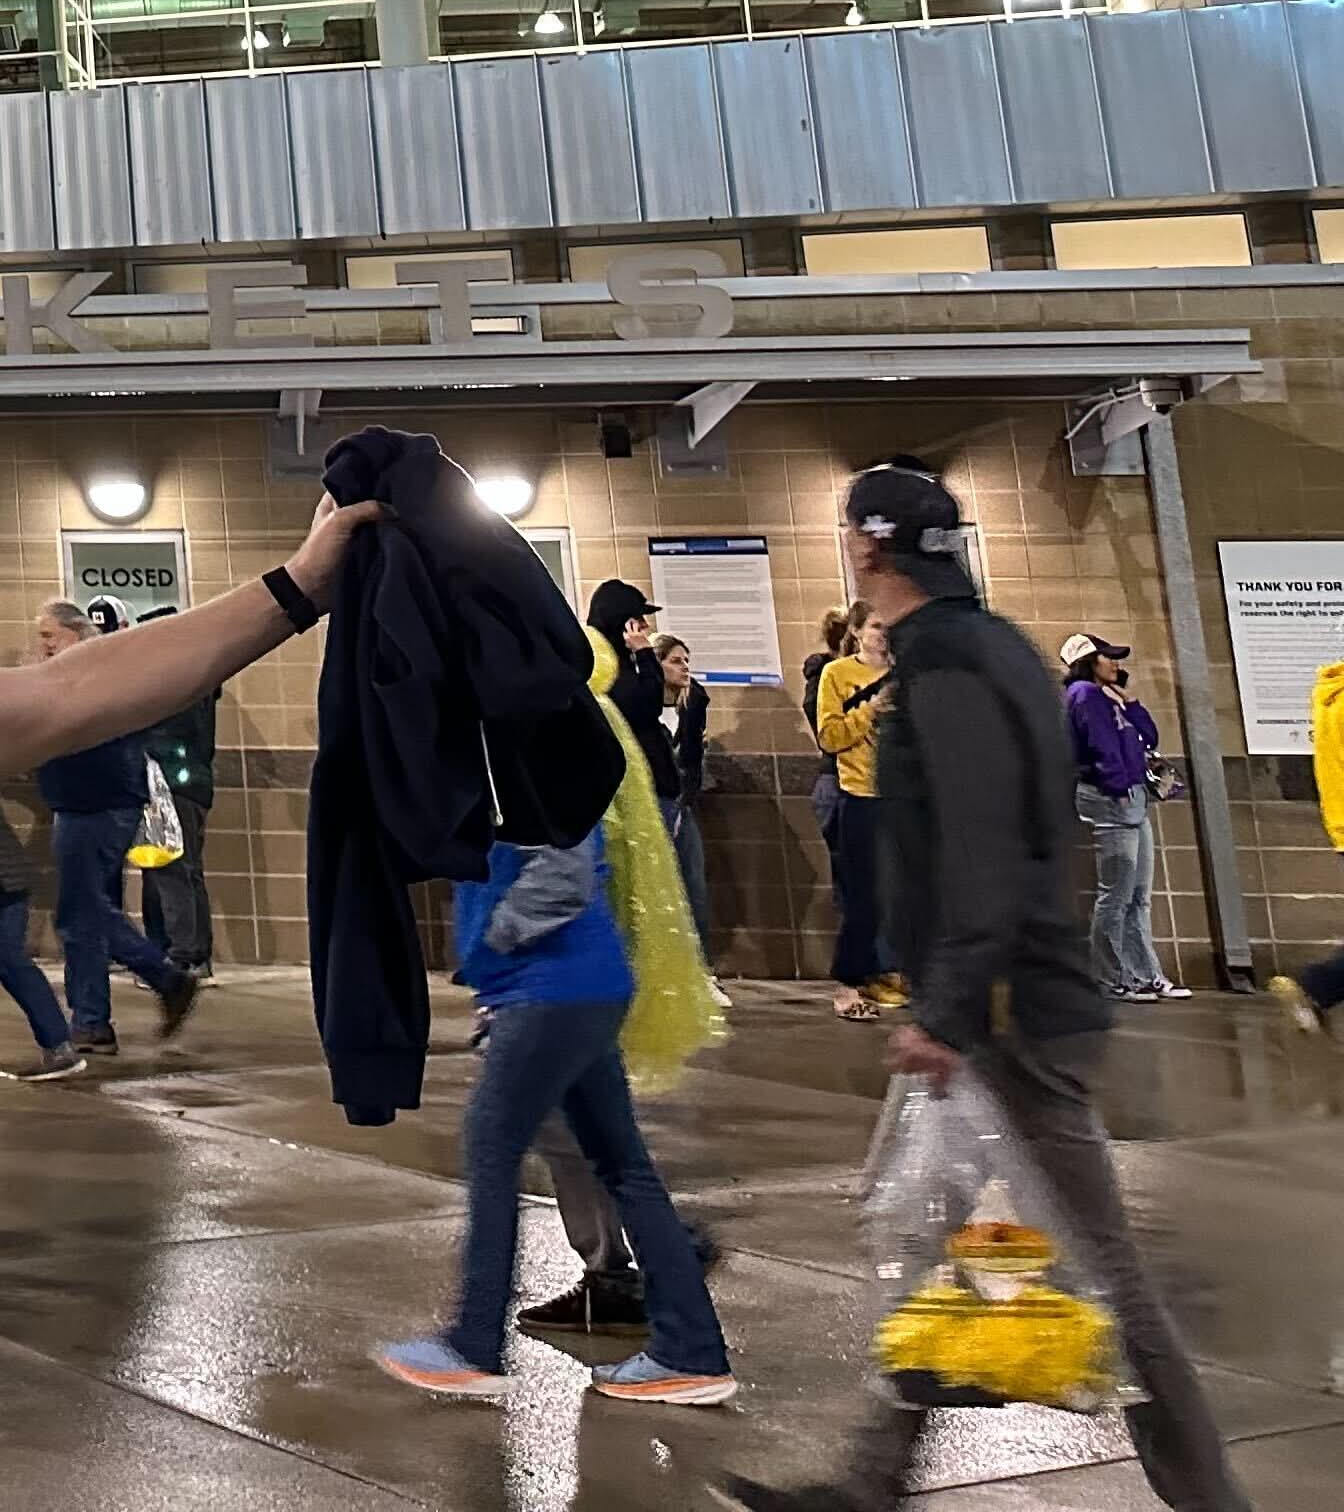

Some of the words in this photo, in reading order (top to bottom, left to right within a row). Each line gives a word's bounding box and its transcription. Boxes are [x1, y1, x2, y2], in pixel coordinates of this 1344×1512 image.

[81, 568, 174, 587] CLOSED
[1236, 581, 1282, 592] THANK
[1285, 581, 1313, 592] YOU
[1316, 581, 1343, 592] FOR
